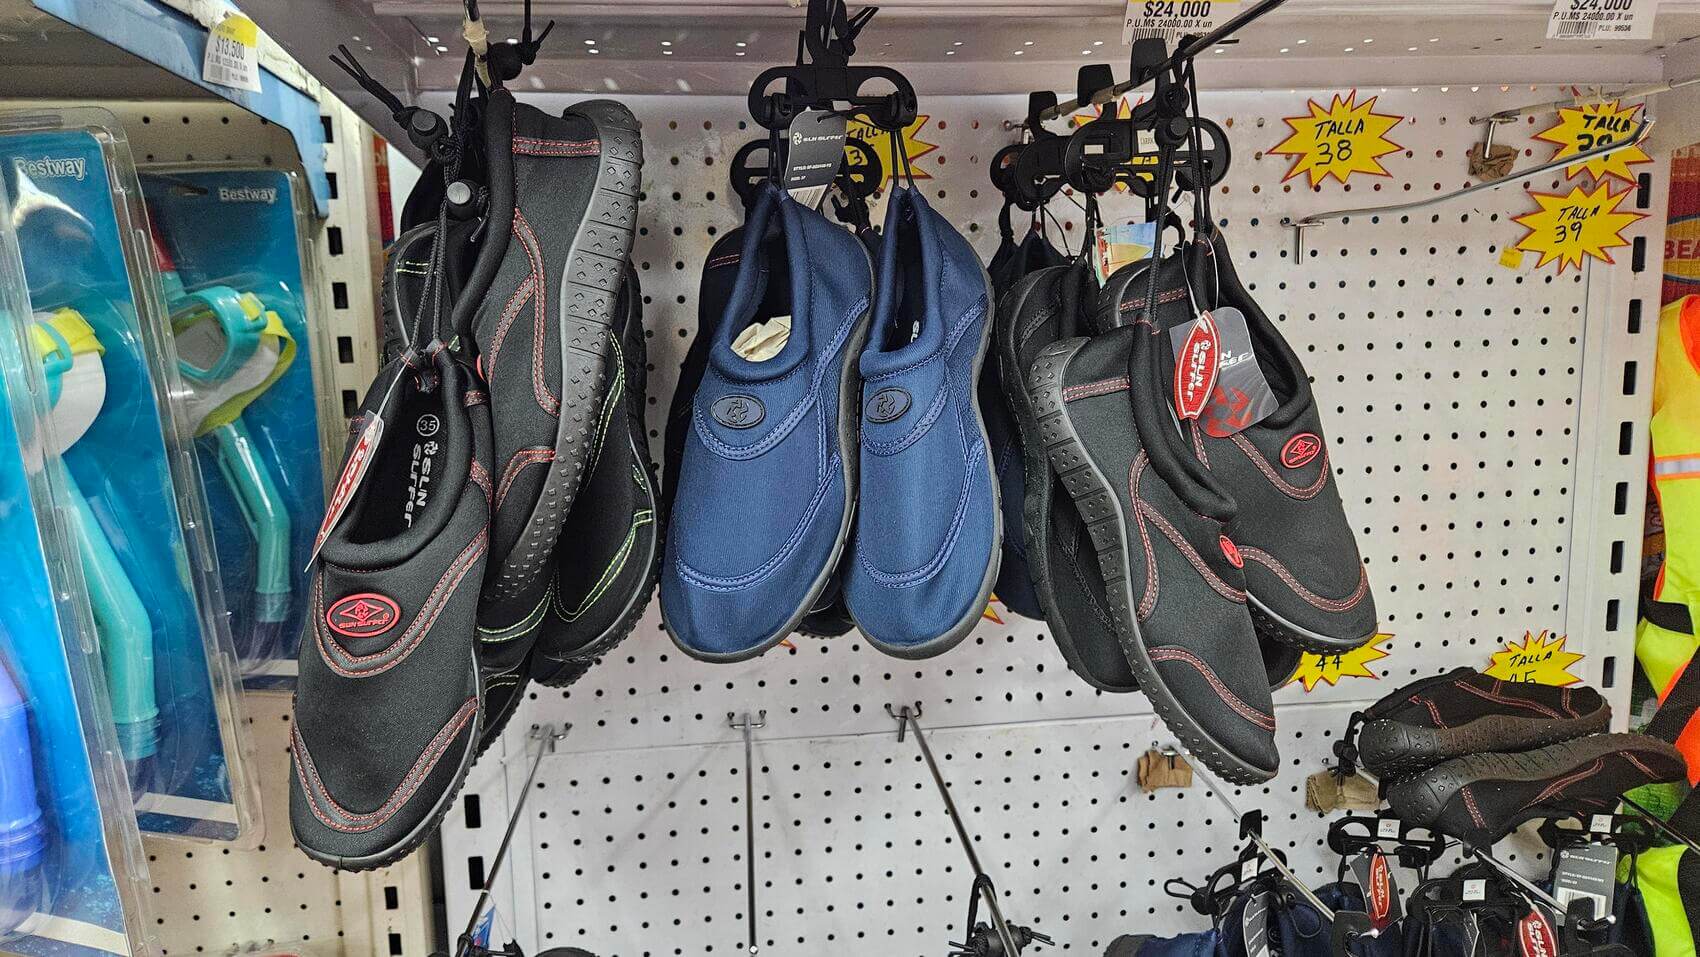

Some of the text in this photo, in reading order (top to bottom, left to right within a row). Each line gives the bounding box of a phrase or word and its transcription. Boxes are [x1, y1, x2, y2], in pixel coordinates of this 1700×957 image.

[1143, 0, 1211, 19] $24,000
[1158, 19, 1193, 28] 24000.00
[1315, 118, 1364, 140] TALLA
[1582, 114, 1631, 132] TALLA
[1315, 139, 1352, 166] 38
[14, 156, 86, 181] Bestway
[218, 187, 278, 204] Bestway
[1554, 223, 1582, 243] 39
[420, 420, 436, 431] 35
[416, 458, 431, 507] SUN
[1510, 651, 1552, 667] TALLA
